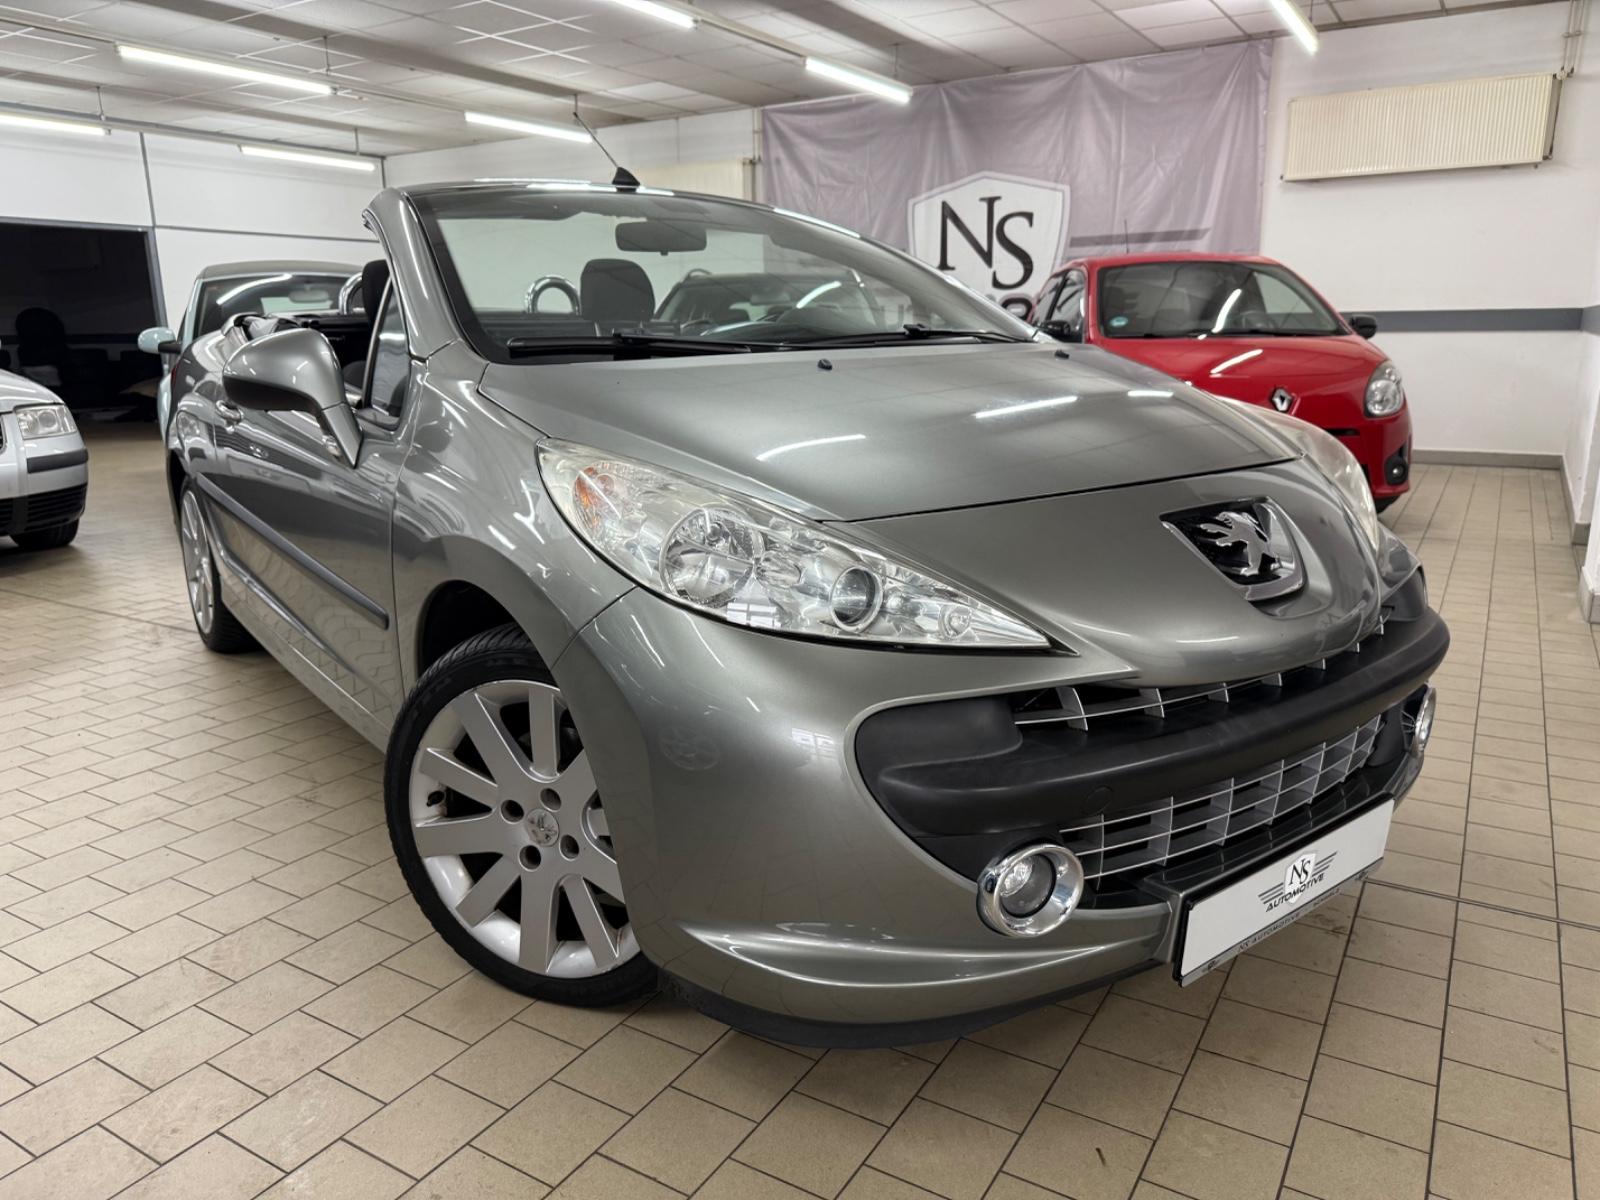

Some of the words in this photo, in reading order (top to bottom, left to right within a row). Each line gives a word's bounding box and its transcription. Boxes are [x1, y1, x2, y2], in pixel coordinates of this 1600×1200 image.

[938, 196, 1034, 290] NS
[1289, 858, 1311, 885] NS
[1265, 873, 1324, 912] AUTOMOTIVE
